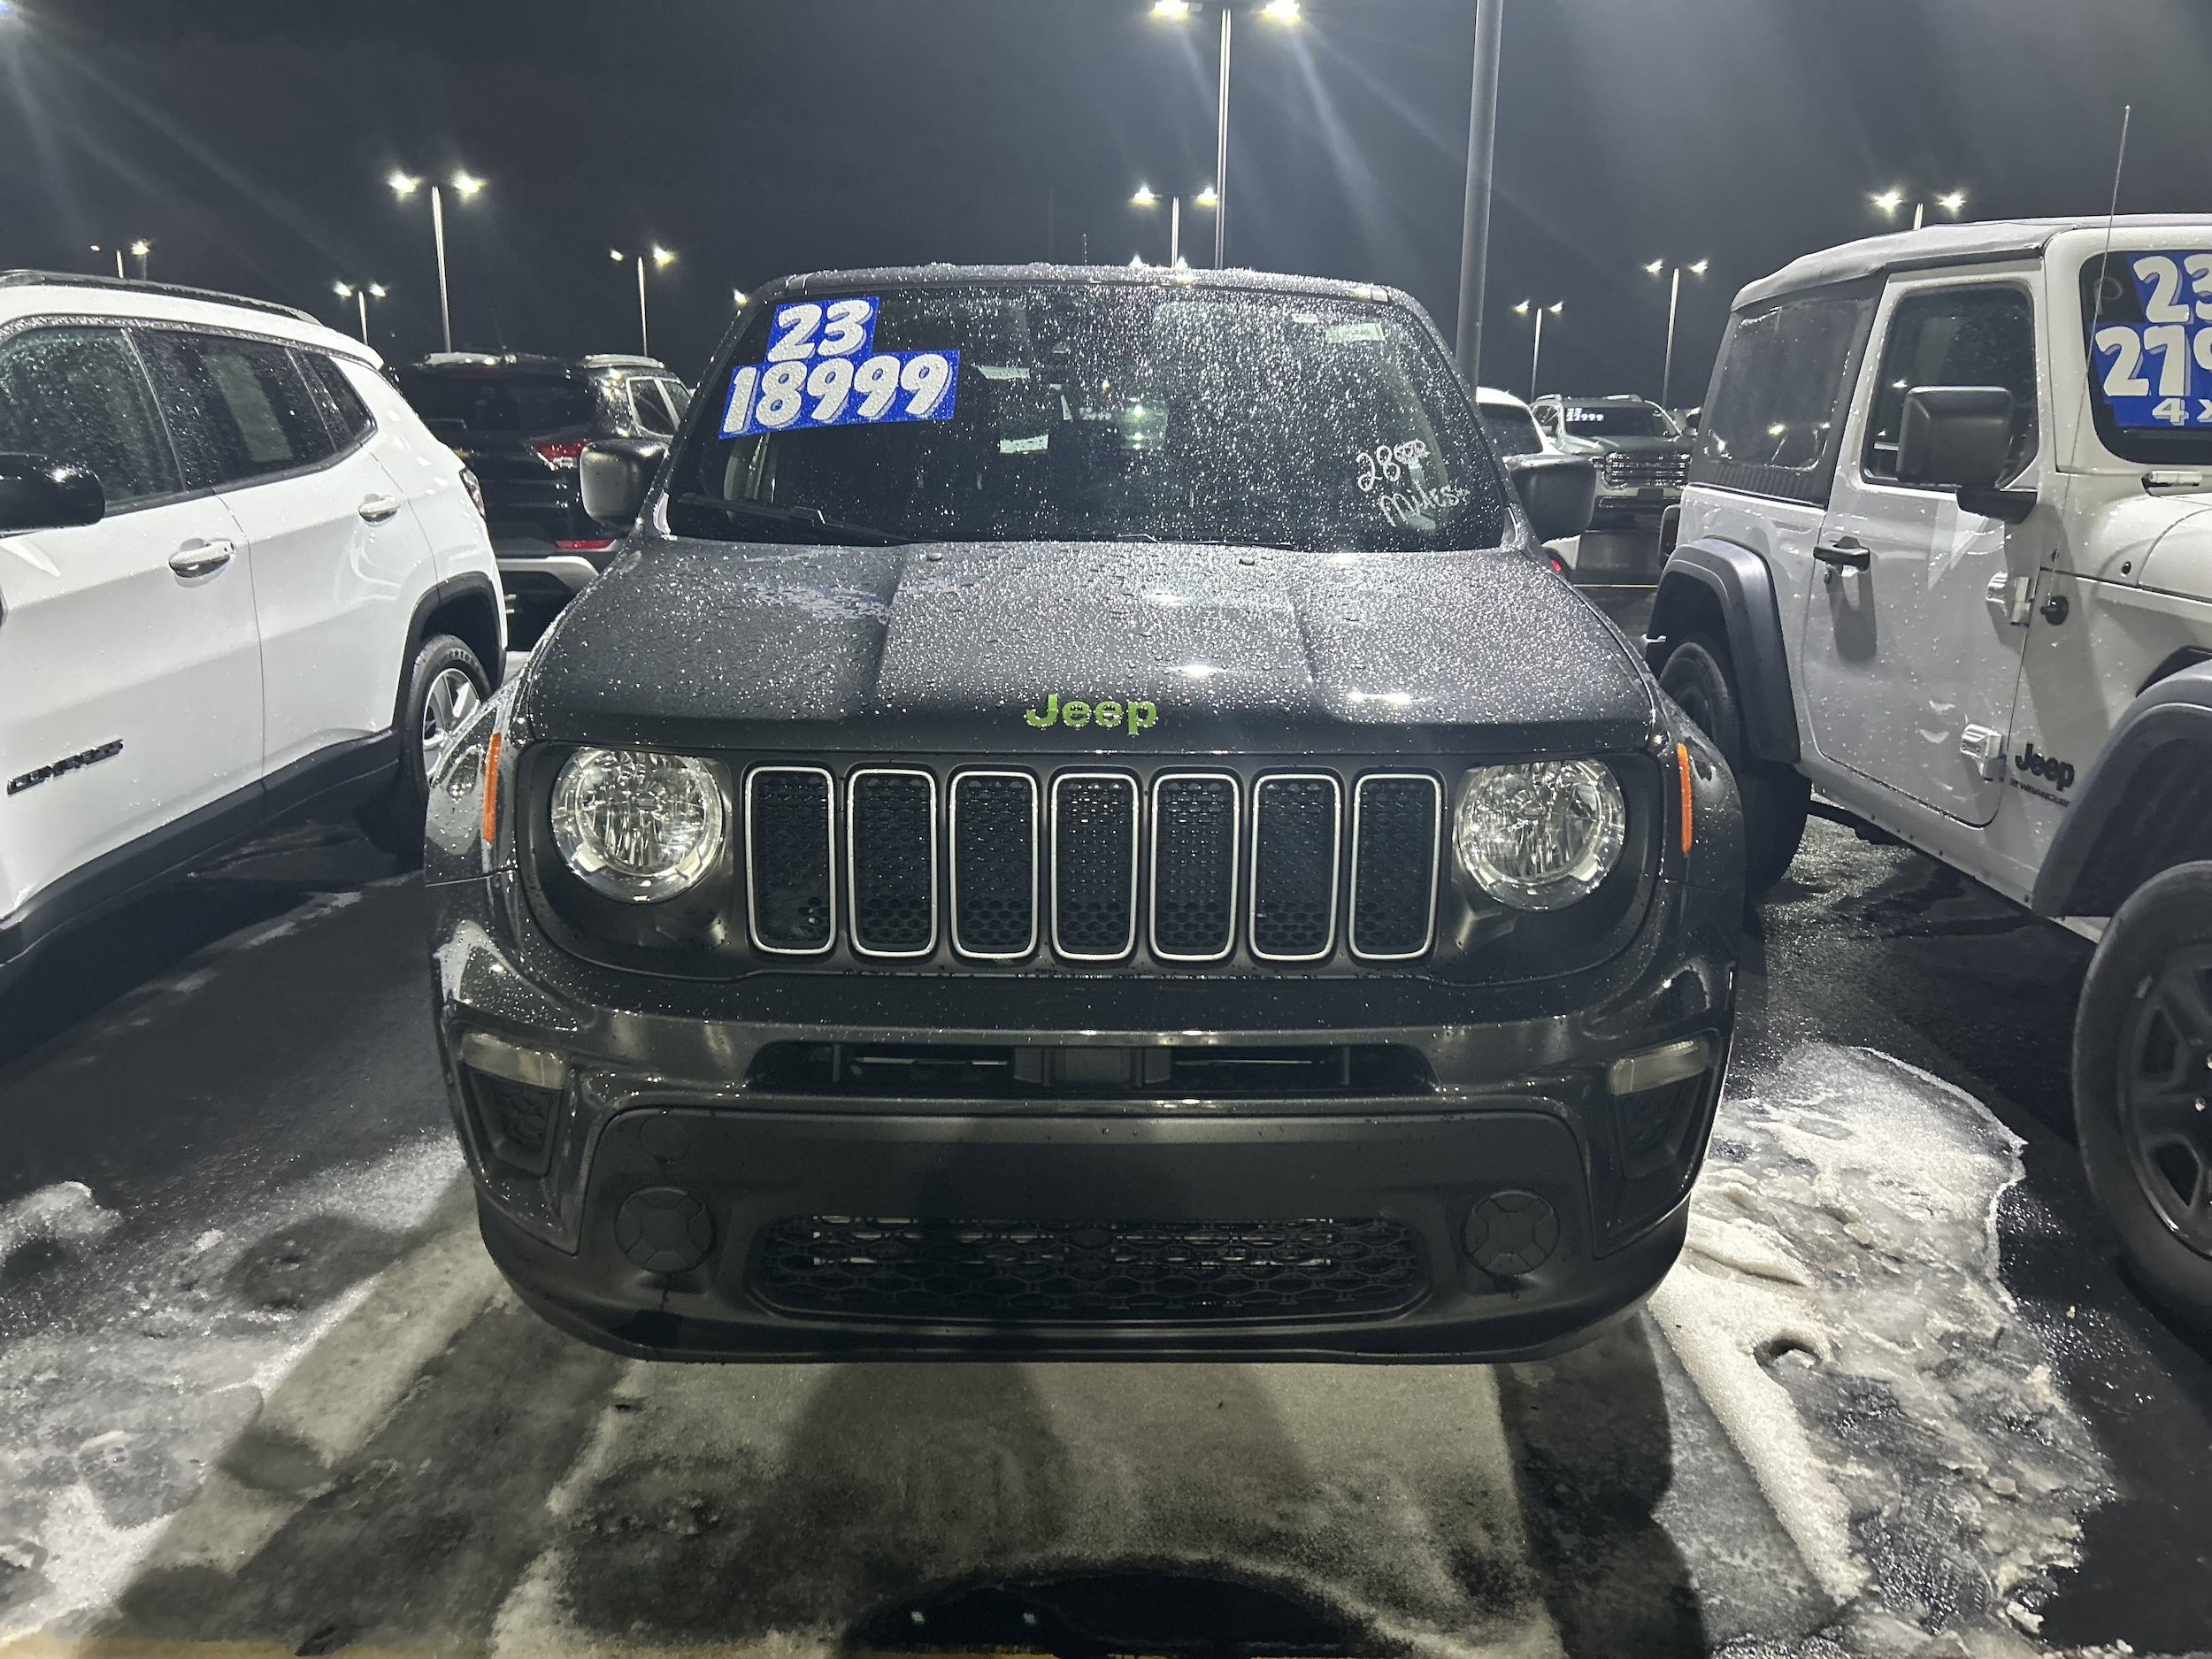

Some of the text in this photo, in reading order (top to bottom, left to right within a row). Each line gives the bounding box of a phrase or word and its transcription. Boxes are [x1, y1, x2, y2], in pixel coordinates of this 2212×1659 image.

[767, 298, 873, 363] 23
[723, 353, 953, 434] 18999
[1025, 694, 1158, 735] Jeep
[2015, 742, 2075, 792] Jeep
